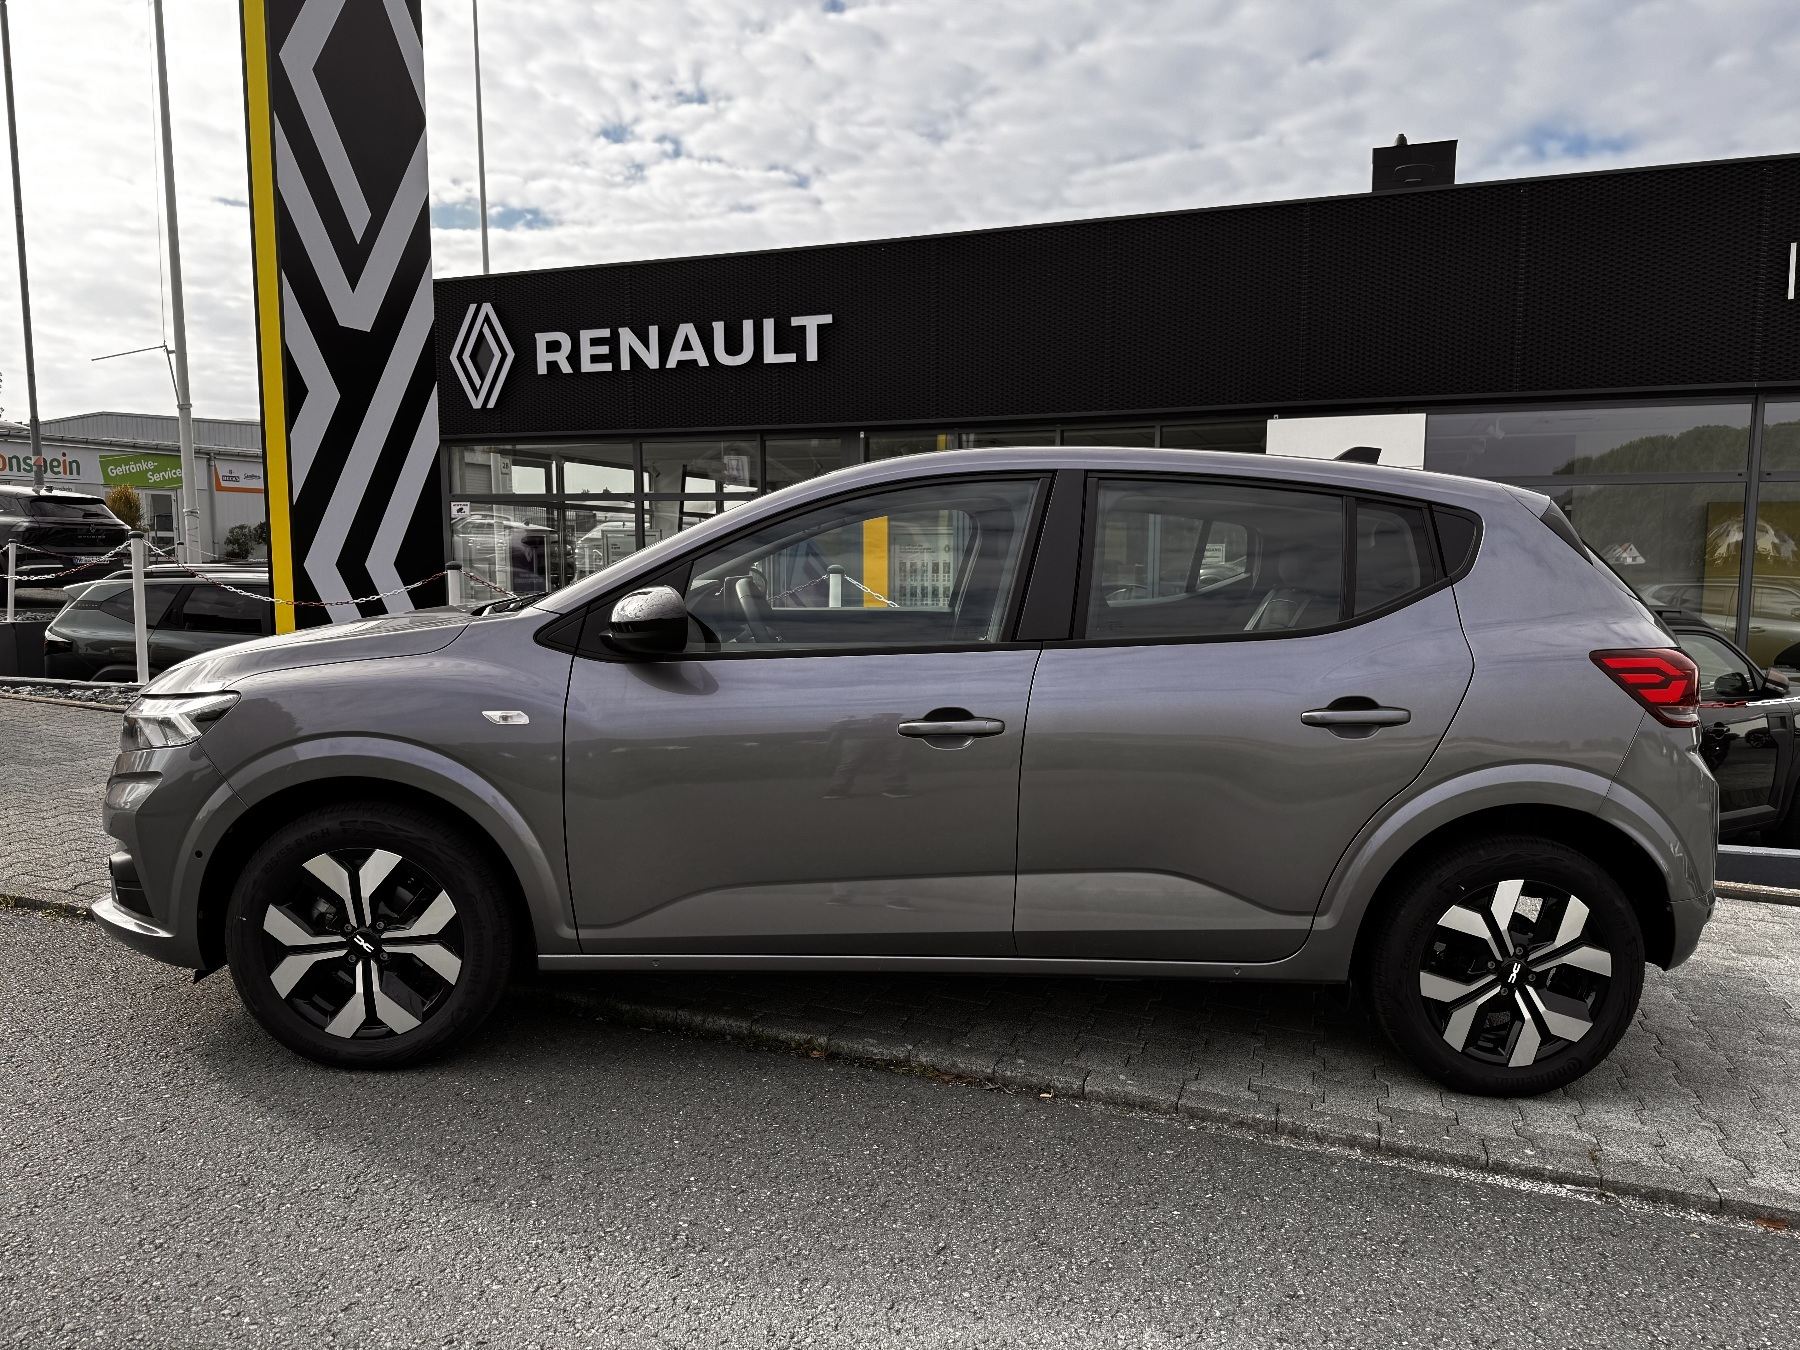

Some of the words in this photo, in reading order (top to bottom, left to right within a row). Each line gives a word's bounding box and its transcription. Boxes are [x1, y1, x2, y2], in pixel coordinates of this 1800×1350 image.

[534, 313, 833, 375] RENAULT
[107, 459, 158, 477] Getränke-
[147, 467, 182, 483] Service
